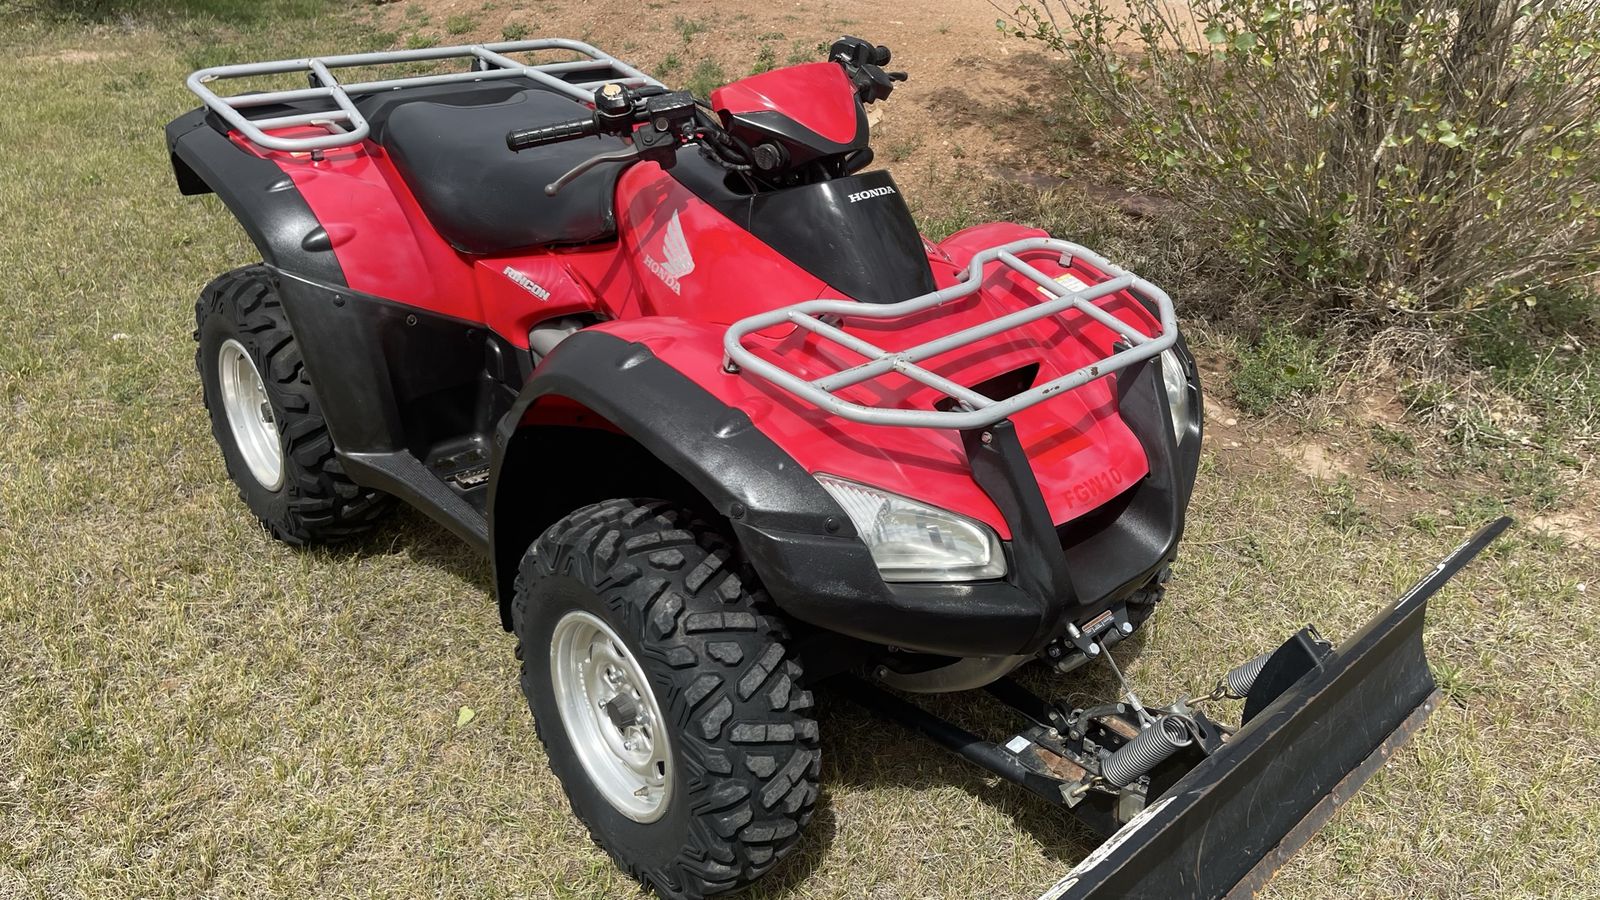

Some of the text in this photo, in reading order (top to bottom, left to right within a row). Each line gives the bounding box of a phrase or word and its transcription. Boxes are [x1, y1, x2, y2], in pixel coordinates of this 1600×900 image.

[848, 186, 896, 203] HONDA
[502, 266, 551, 301] RINCON
[643, 254, 681, 296] HONDA
